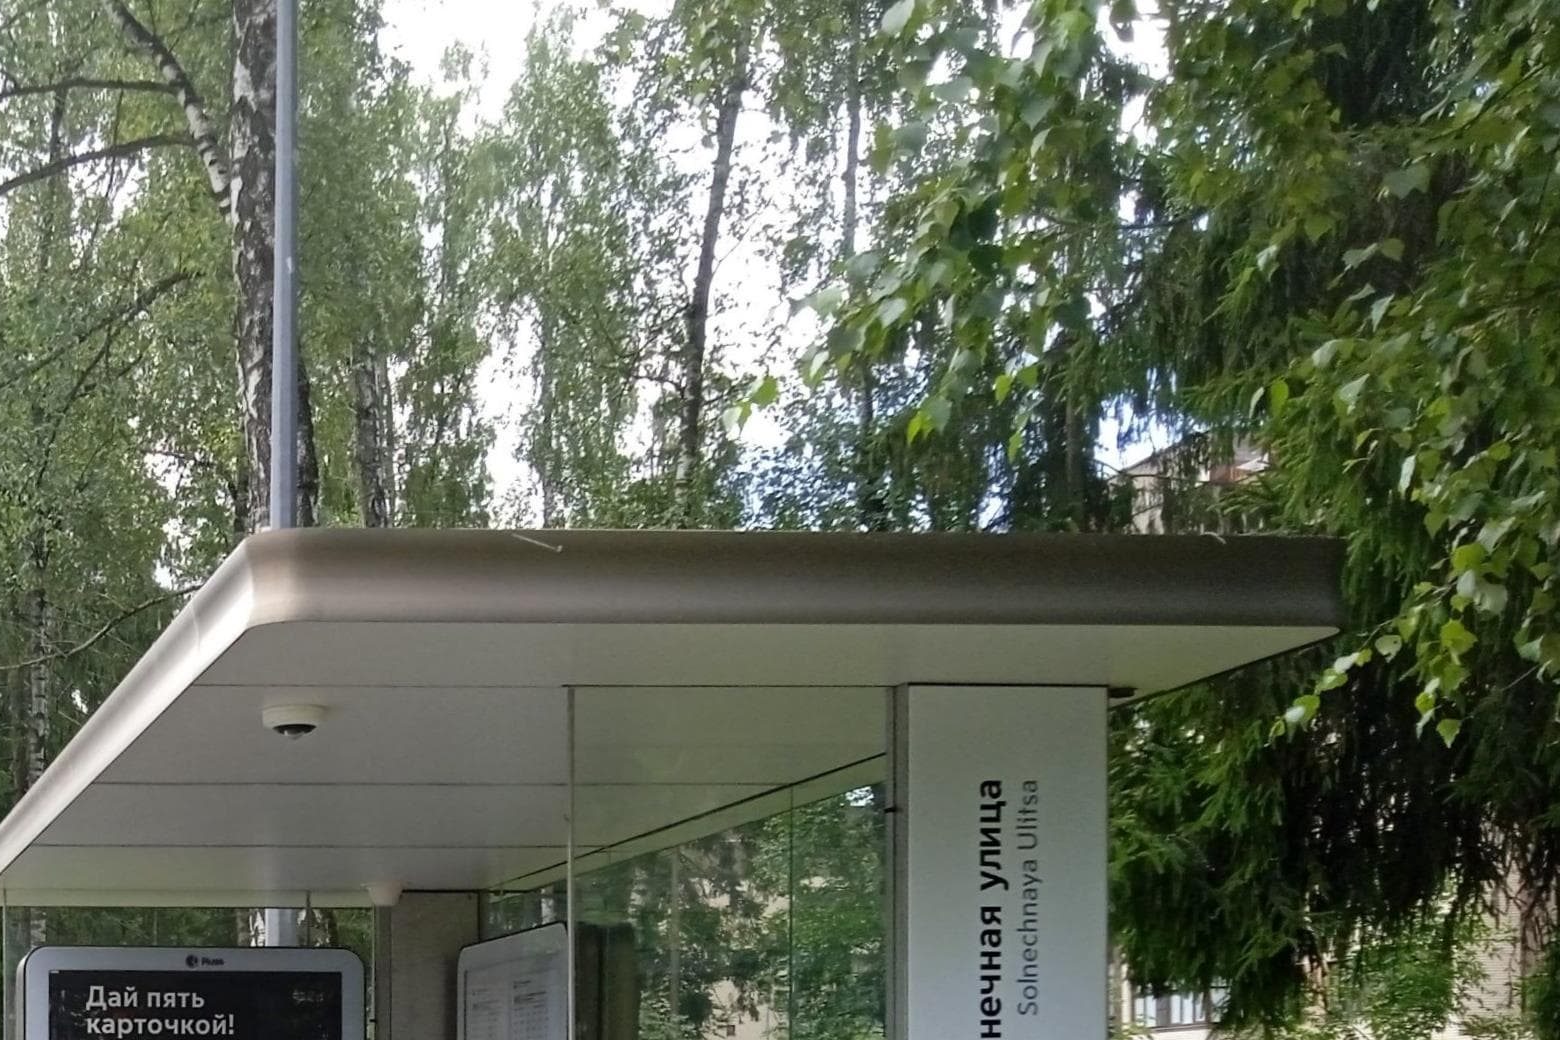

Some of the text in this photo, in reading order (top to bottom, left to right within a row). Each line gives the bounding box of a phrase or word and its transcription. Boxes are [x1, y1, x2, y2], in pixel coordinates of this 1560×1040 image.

[979, 778, 1009, 892] улица
[1016, 779, 1043, 1016] Solnechnaya Ulitsa
[85, 984, 205, 1011] Дай пять
[86, 1013, 235, 1039] карточкой!
